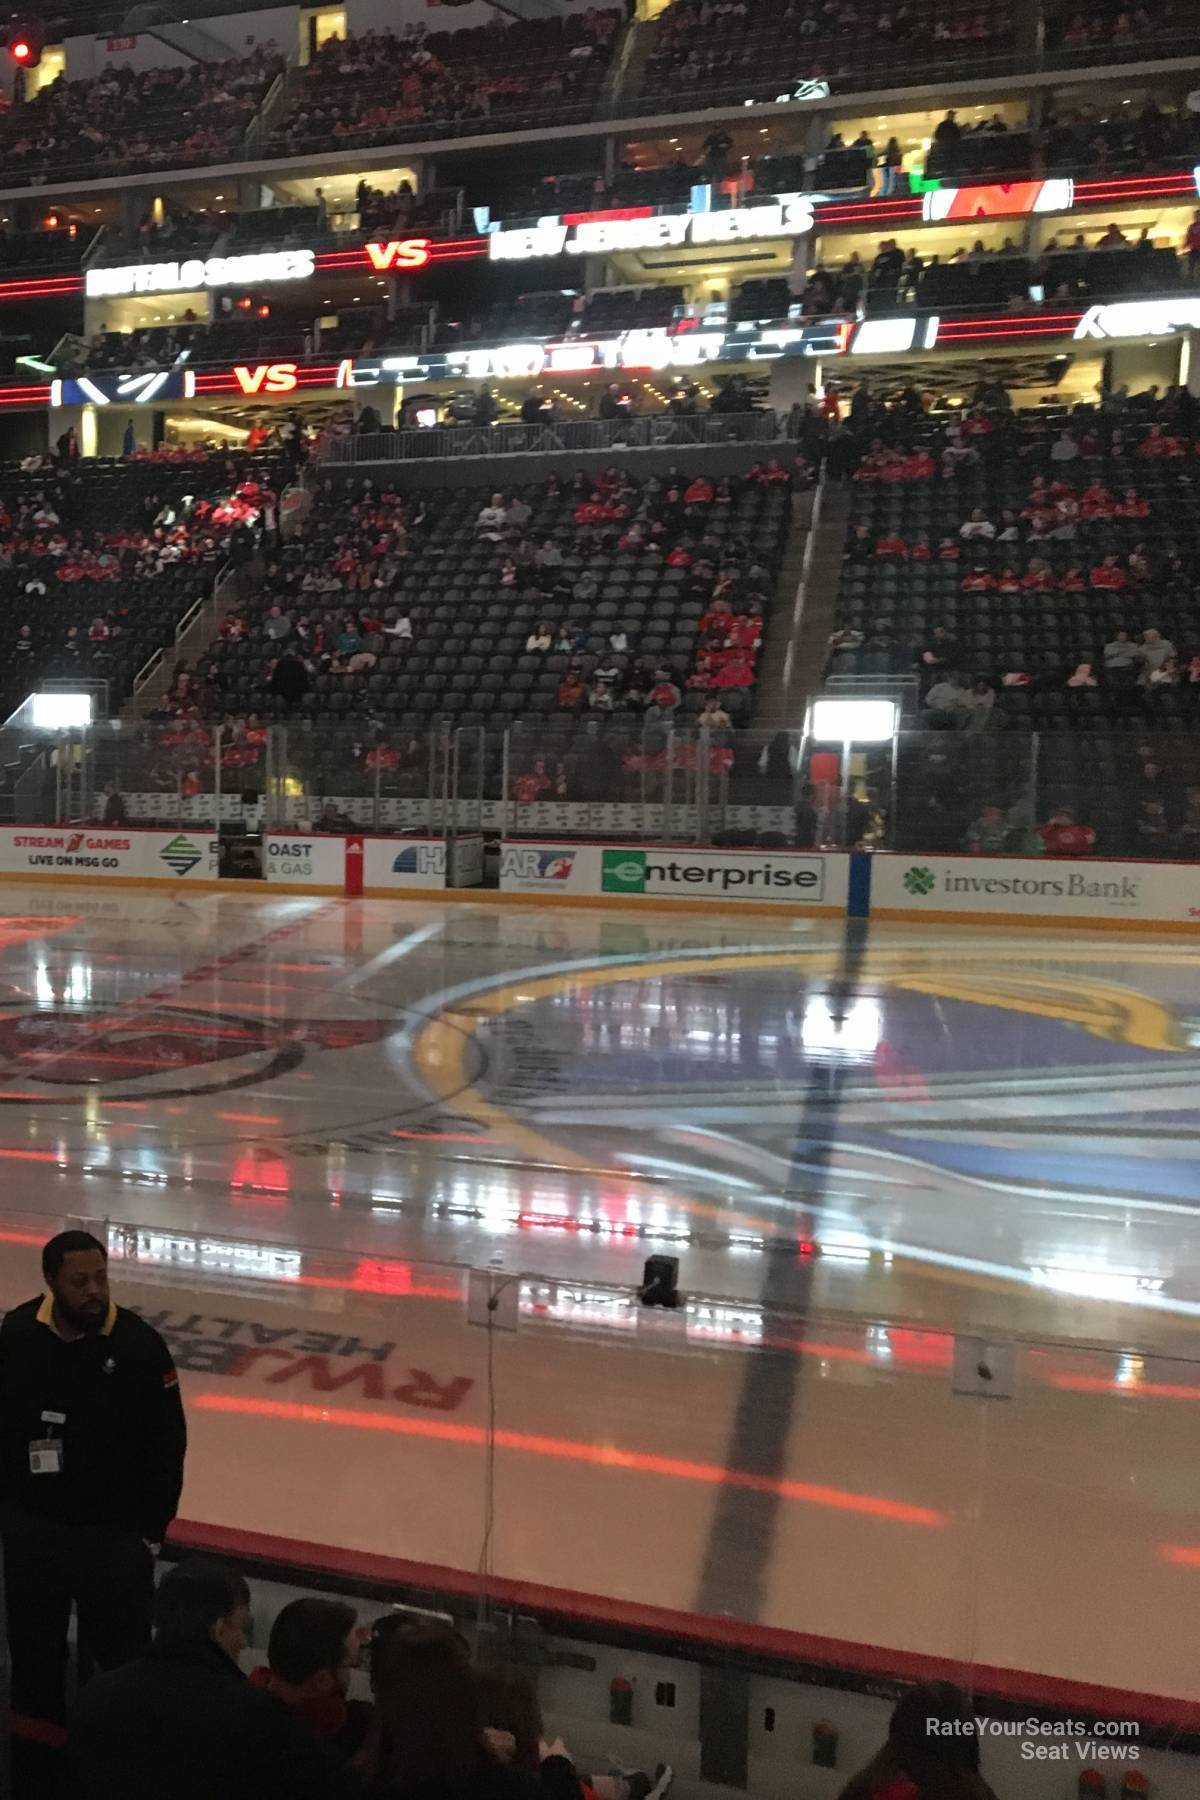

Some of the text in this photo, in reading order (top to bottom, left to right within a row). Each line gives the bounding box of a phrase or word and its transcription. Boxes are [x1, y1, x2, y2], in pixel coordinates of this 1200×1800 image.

[366, 239, 431, 271] VS
[232, 363, 298, 393] VS
[13, 836, 131, 850] STREAM GAMES
[268, 842, 313, 857] OAST
[29, 855, 119, 868] LIVE ON MSG GO
[280, 863, 313, 876] GAS
[612, 861, 818, 890] enterprise
